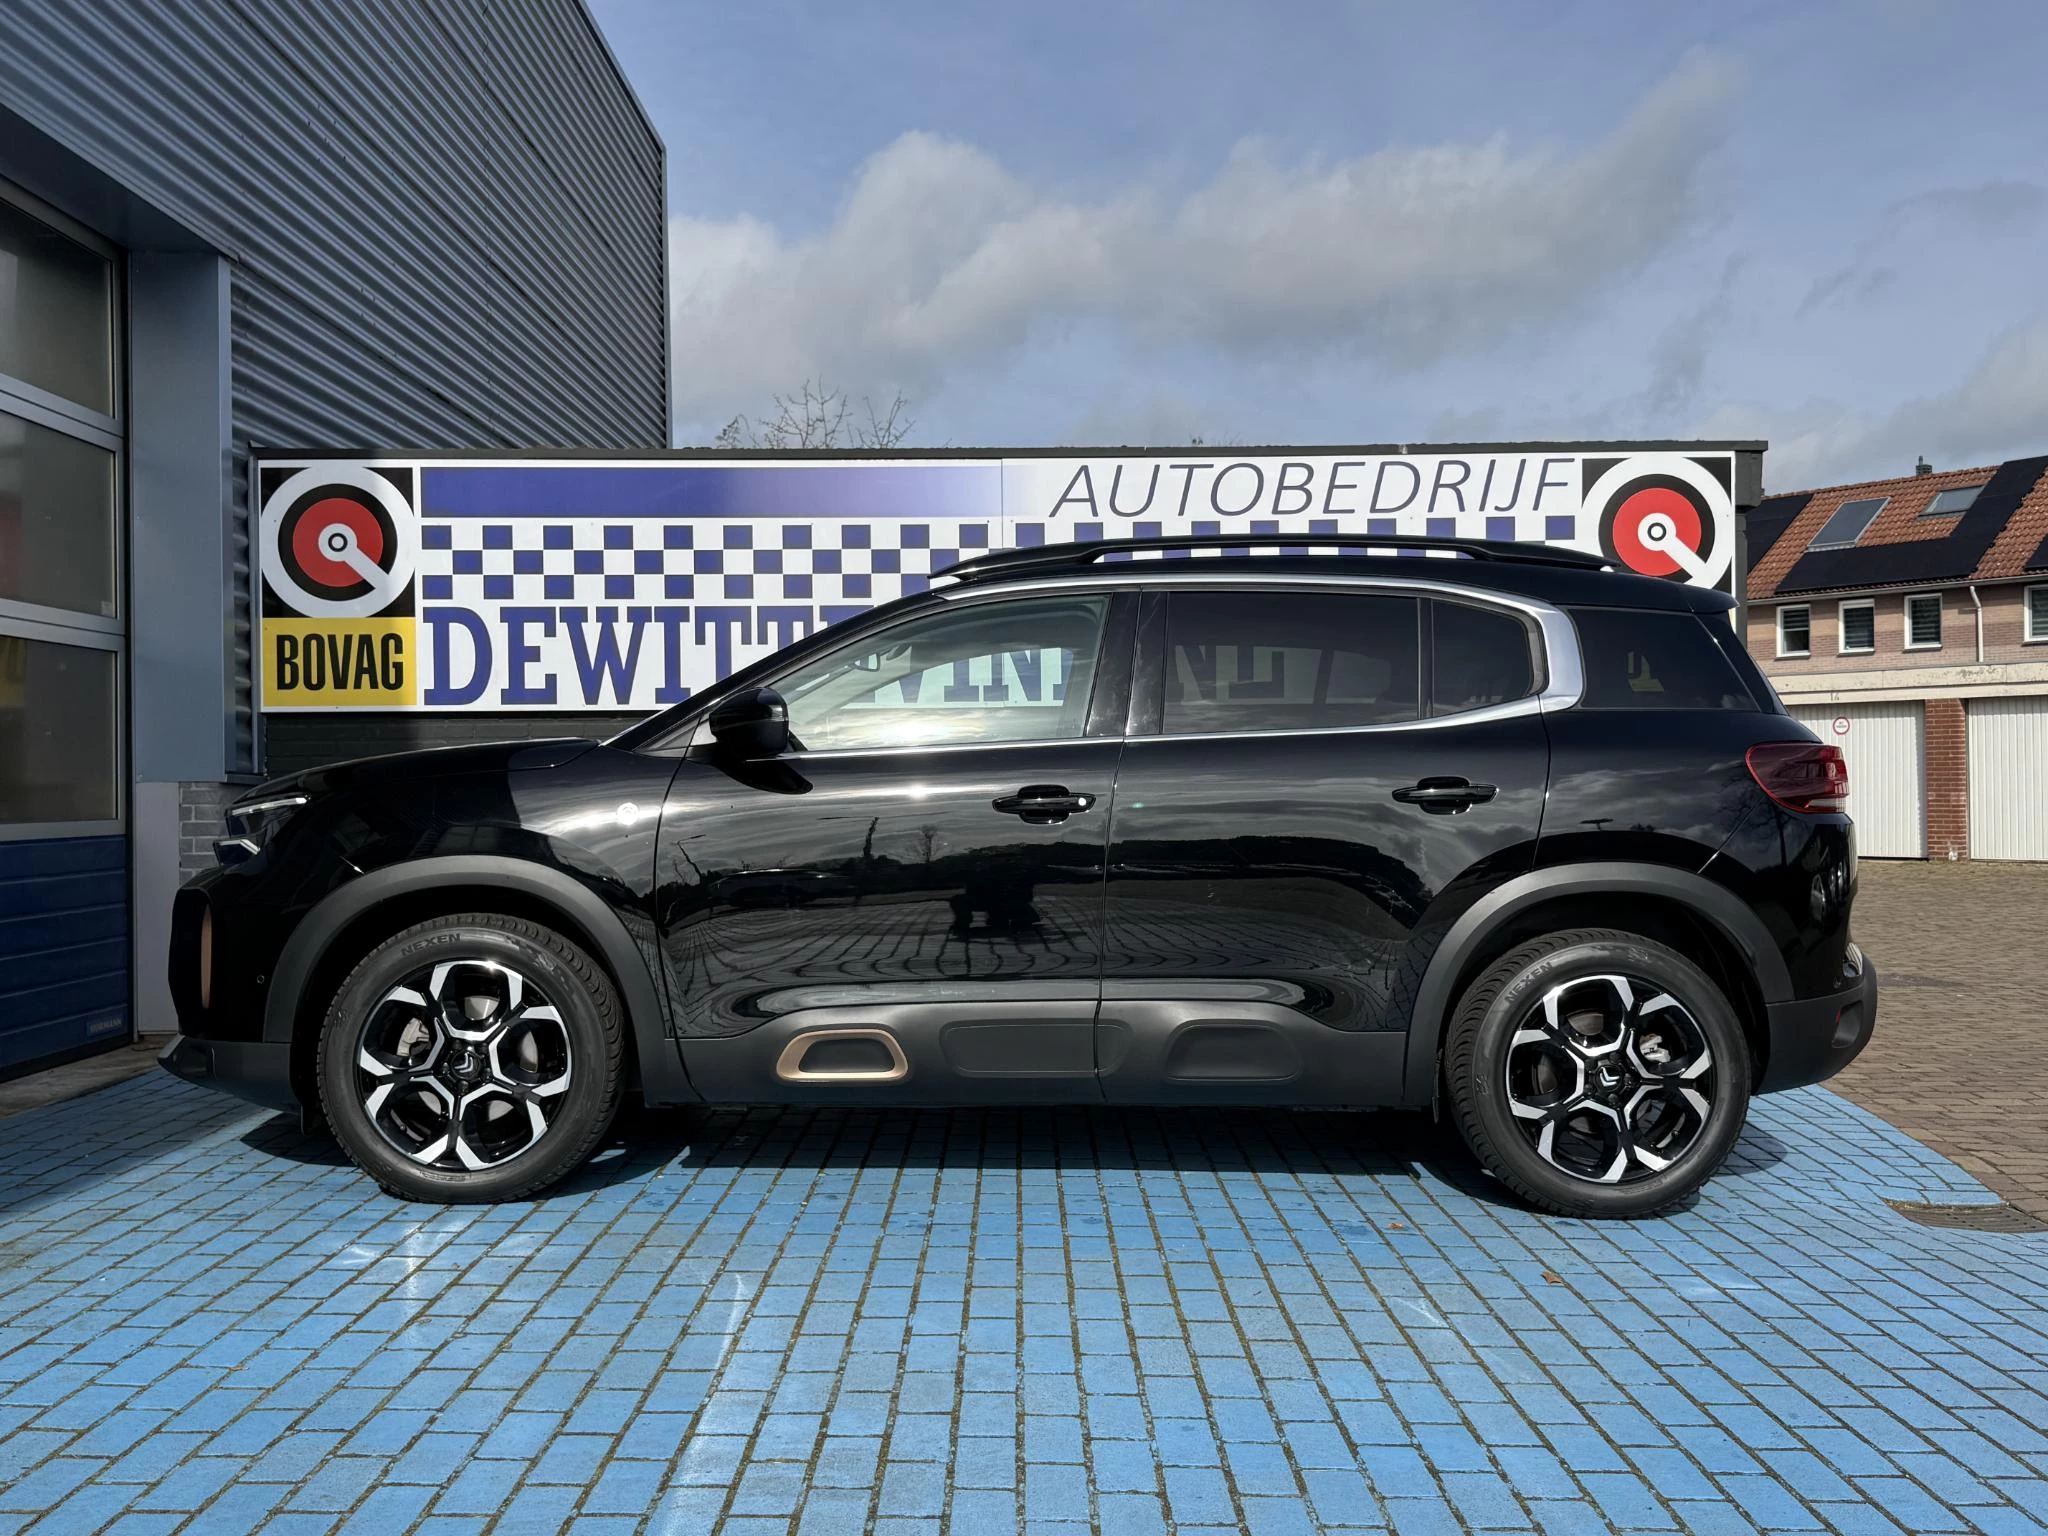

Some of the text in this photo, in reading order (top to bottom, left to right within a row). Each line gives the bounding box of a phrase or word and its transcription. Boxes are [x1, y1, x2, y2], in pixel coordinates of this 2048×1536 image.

[1049, 457, 1576, 517] AUTOBEDRIJF
[276, 632, 404, 691] BOVAG
[402, 933, 461, 956] NEXEN
[1505, 962, 1553, 1002] NEXEN
